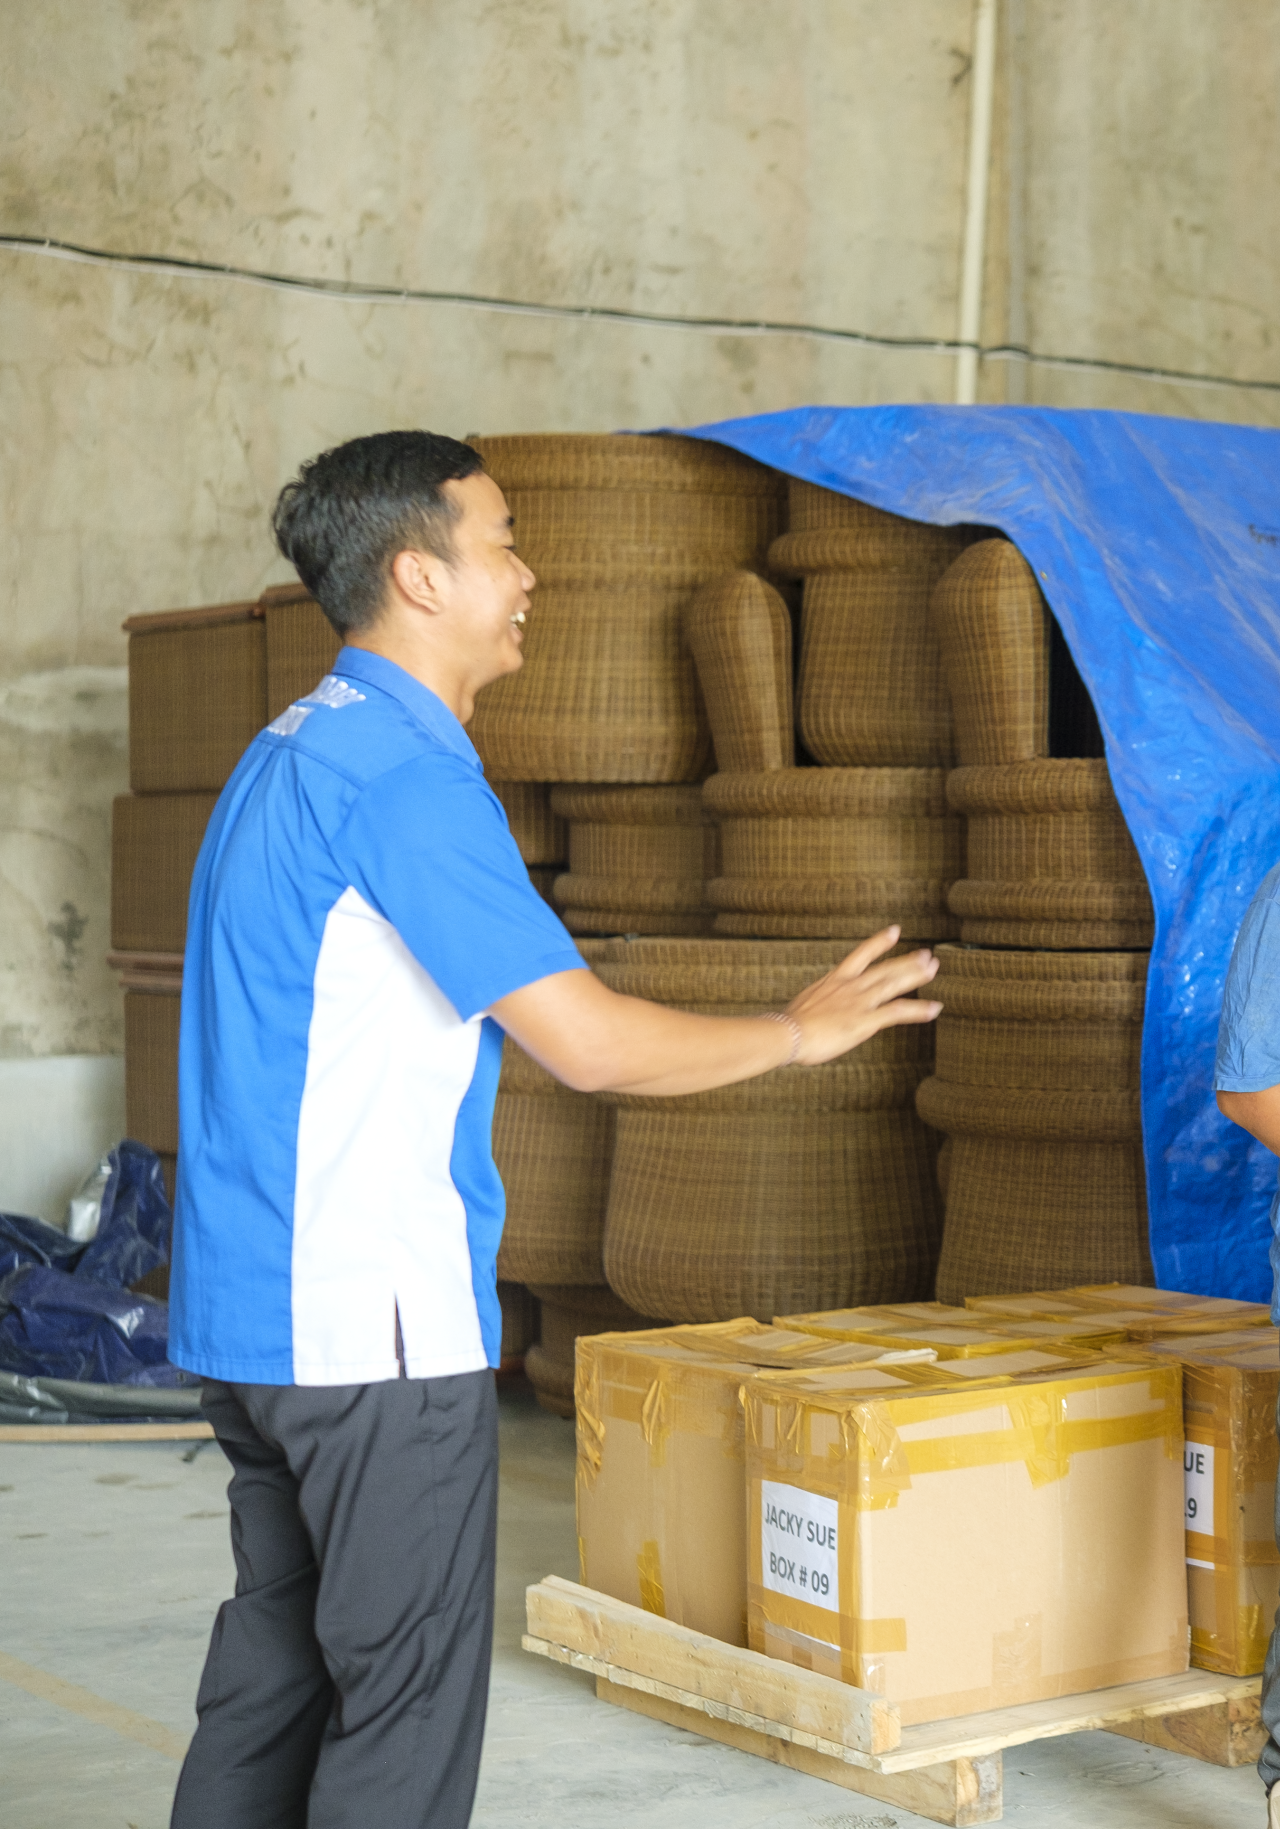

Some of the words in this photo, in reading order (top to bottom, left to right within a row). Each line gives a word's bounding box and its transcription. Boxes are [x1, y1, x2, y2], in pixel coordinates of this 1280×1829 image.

[1184, 1451, 1205, 1475] UE
[1184, 1497, 1197, 1519] 9
[765, 1502, 803, 1538] JACKY
[806, 1520, 836, 1551] SUE
[770, 1551, 796, 1584] BOX
[799, 1565, 808, 1588] #
[811, 1570, 829, 1595] 09
